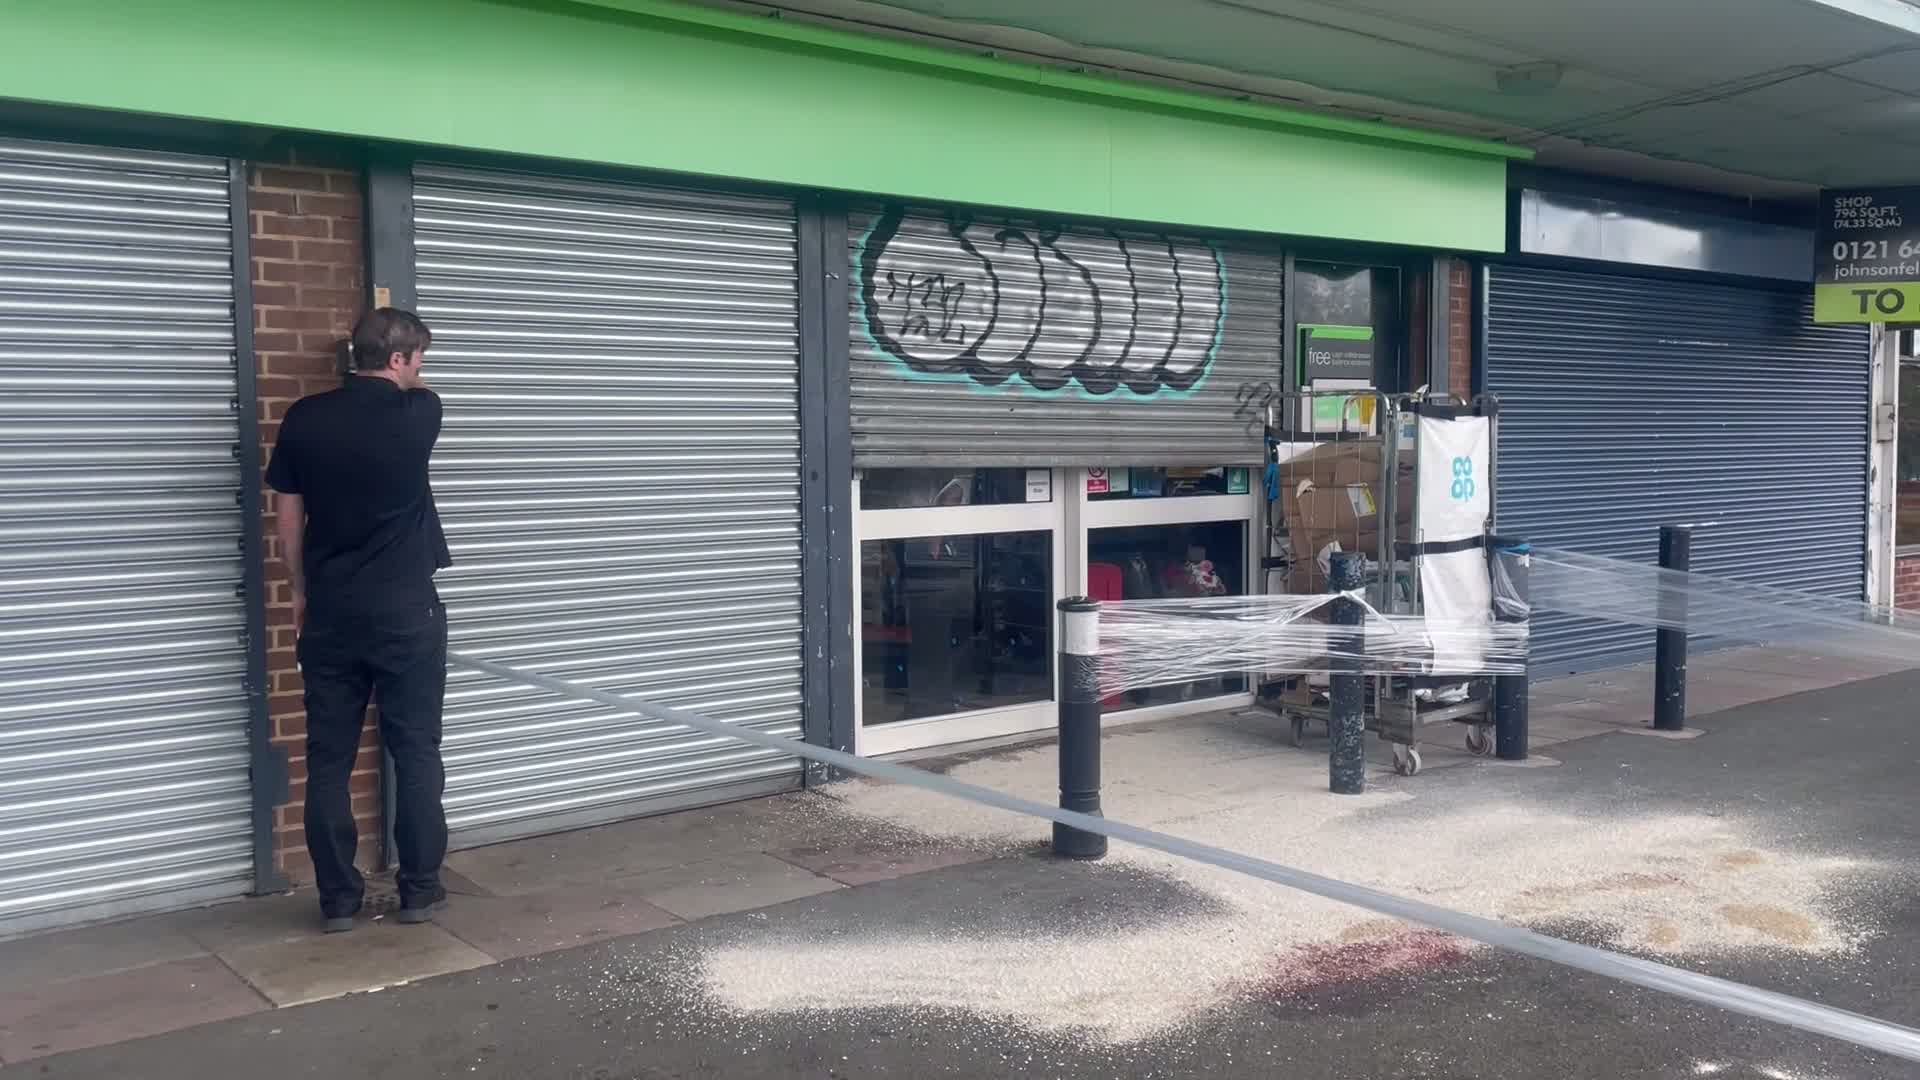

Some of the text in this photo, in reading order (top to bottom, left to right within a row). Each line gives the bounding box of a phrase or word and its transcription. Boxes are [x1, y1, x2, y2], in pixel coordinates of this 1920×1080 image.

[1833, 196, 1873, 208] SHOP
[1834, 208, 1857, 218] 796
[1832, 240, 1889, 261] 0121
[1834, 260, 1920, 281] johnsonfel
[1851, 287, 1905, 315] TO
[1308, 346, 1331, 367] free
